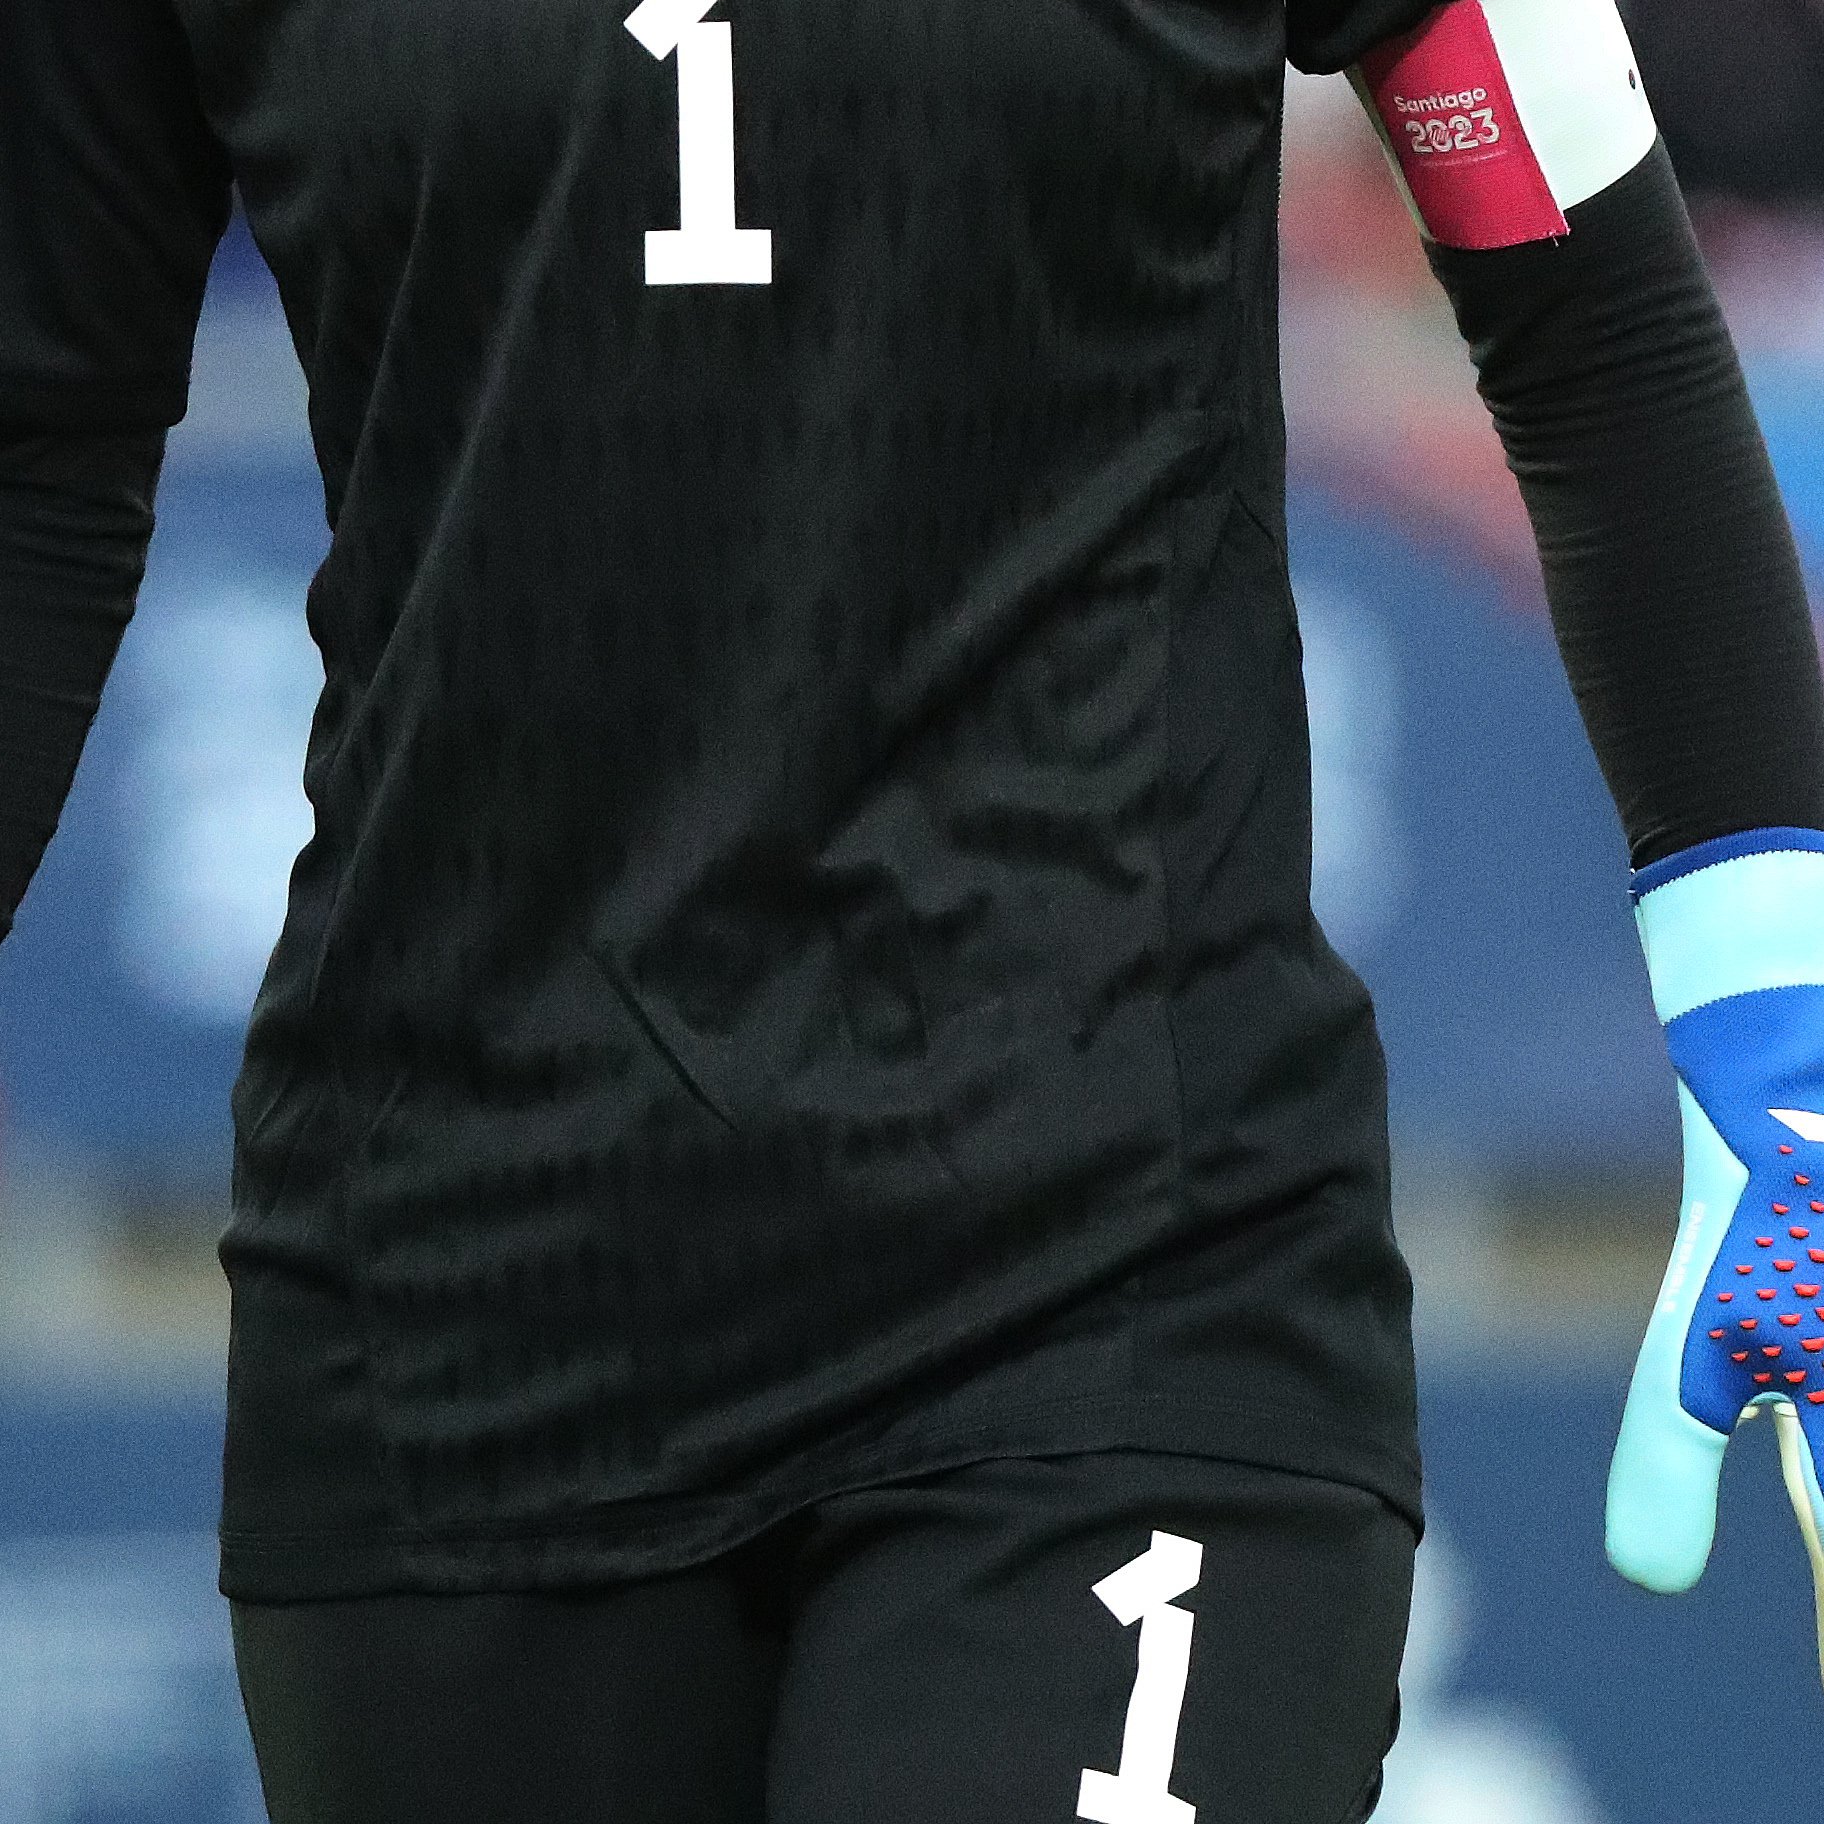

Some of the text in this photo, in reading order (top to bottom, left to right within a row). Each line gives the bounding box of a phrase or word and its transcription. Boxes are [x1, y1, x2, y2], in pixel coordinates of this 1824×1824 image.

[1393, 87, 1488, 112] Santiago
[1405, 107, 1501, 153] 2023
[1076, 1529, 1204, 1824] 1
